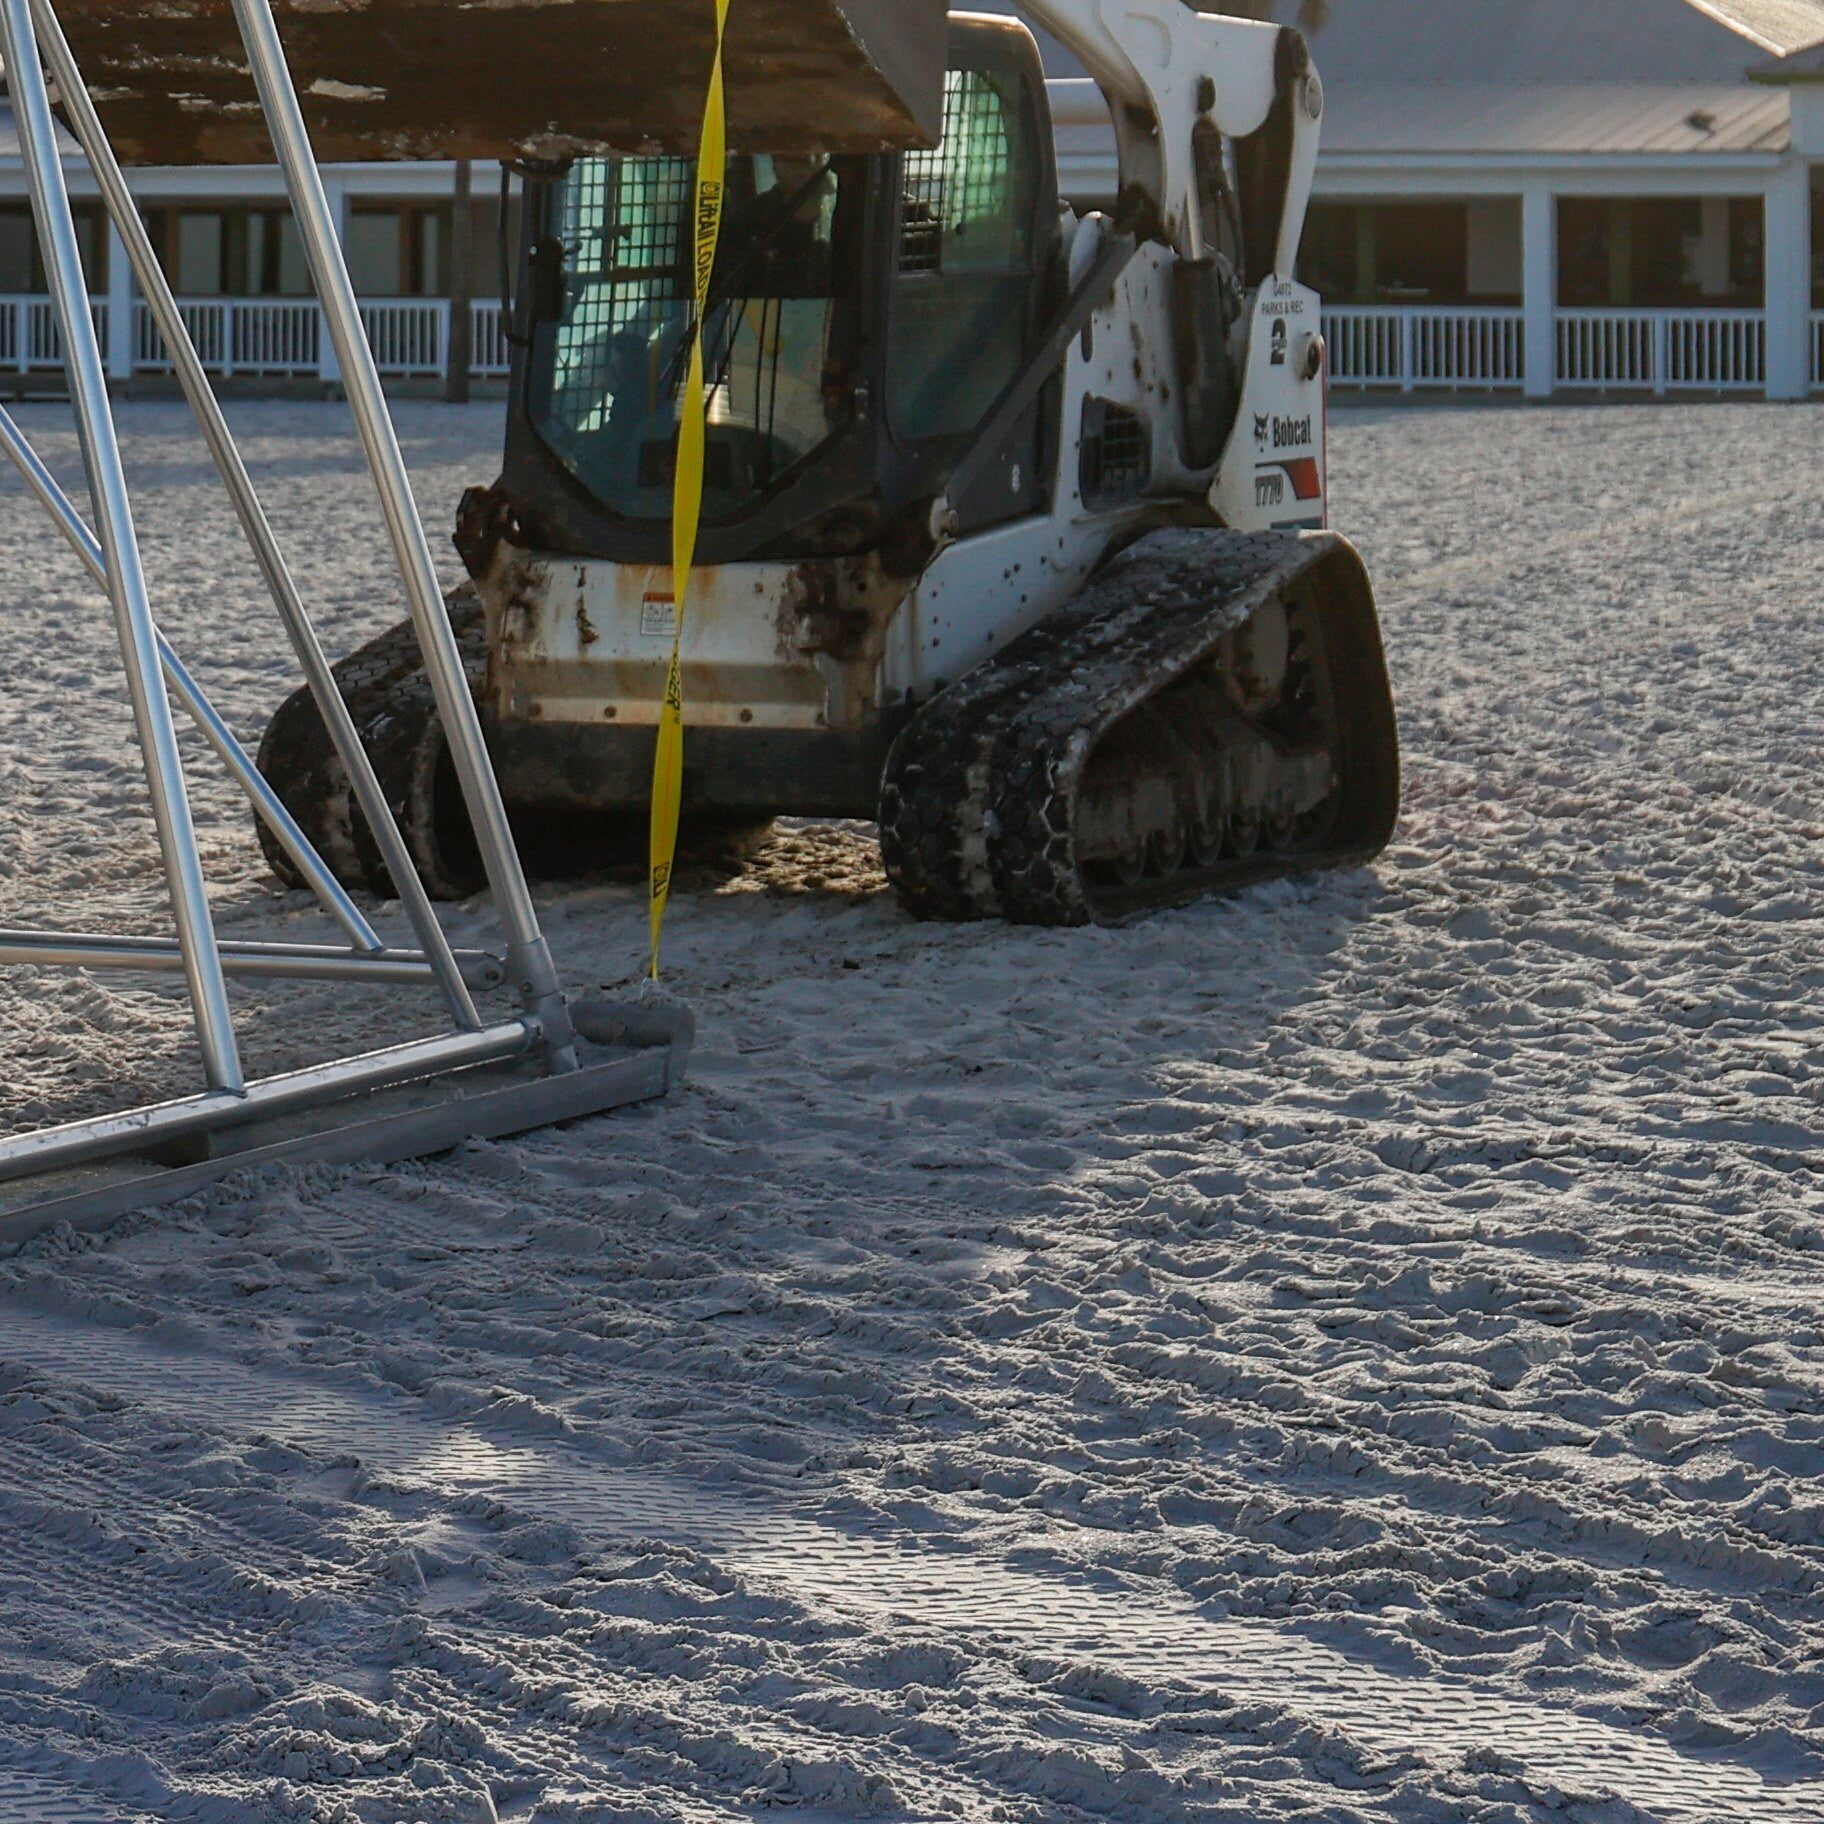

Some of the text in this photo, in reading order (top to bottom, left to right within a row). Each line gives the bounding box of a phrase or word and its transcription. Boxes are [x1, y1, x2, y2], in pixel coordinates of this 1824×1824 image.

[1261, 300, 1283, 315] PARKS
[1290, 299, 1304, 313] REC
[1271, 317, 1287, 365] 2
[1273, 414, 1312, 447] Bobcat
[1255, 473, 1284, 507] T770
